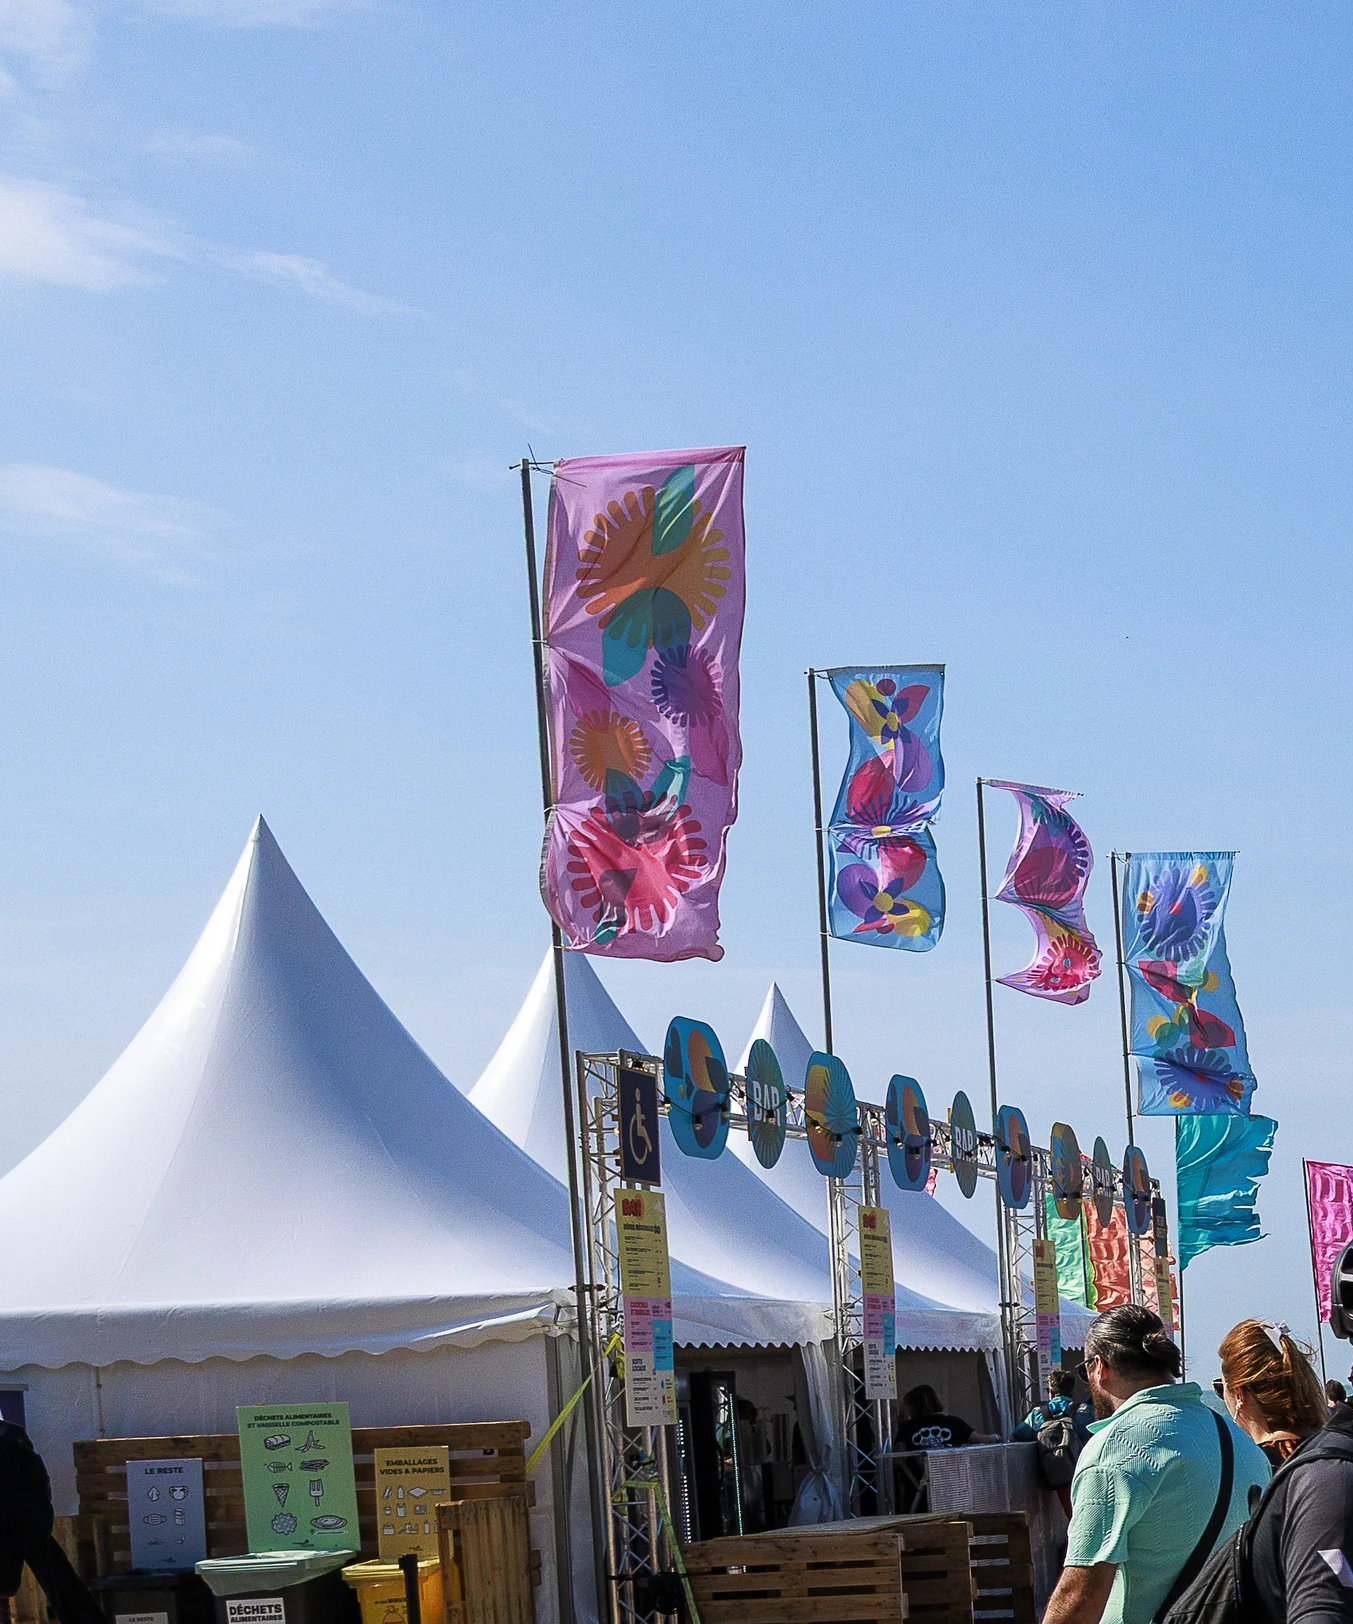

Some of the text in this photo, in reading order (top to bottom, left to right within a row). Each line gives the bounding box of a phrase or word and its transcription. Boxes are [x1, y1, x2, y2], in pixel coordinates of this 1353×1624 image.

[753, 1080, 781, 1126] BAR
[954, 1126, 974, 1162] BAR
[291, 1419, 340, 1427] COMPOSTABLE
[386, 1458, 438, 1466] EMBALLAGES
[144, 1466, 184, 1475] LE RESTE
[411, 1466, 445, 1474] PAPIERS
[229, 1604, 282, 1616] DÉCHETS
[230, 1614, 283, 1623] ALIMENTAIRES
